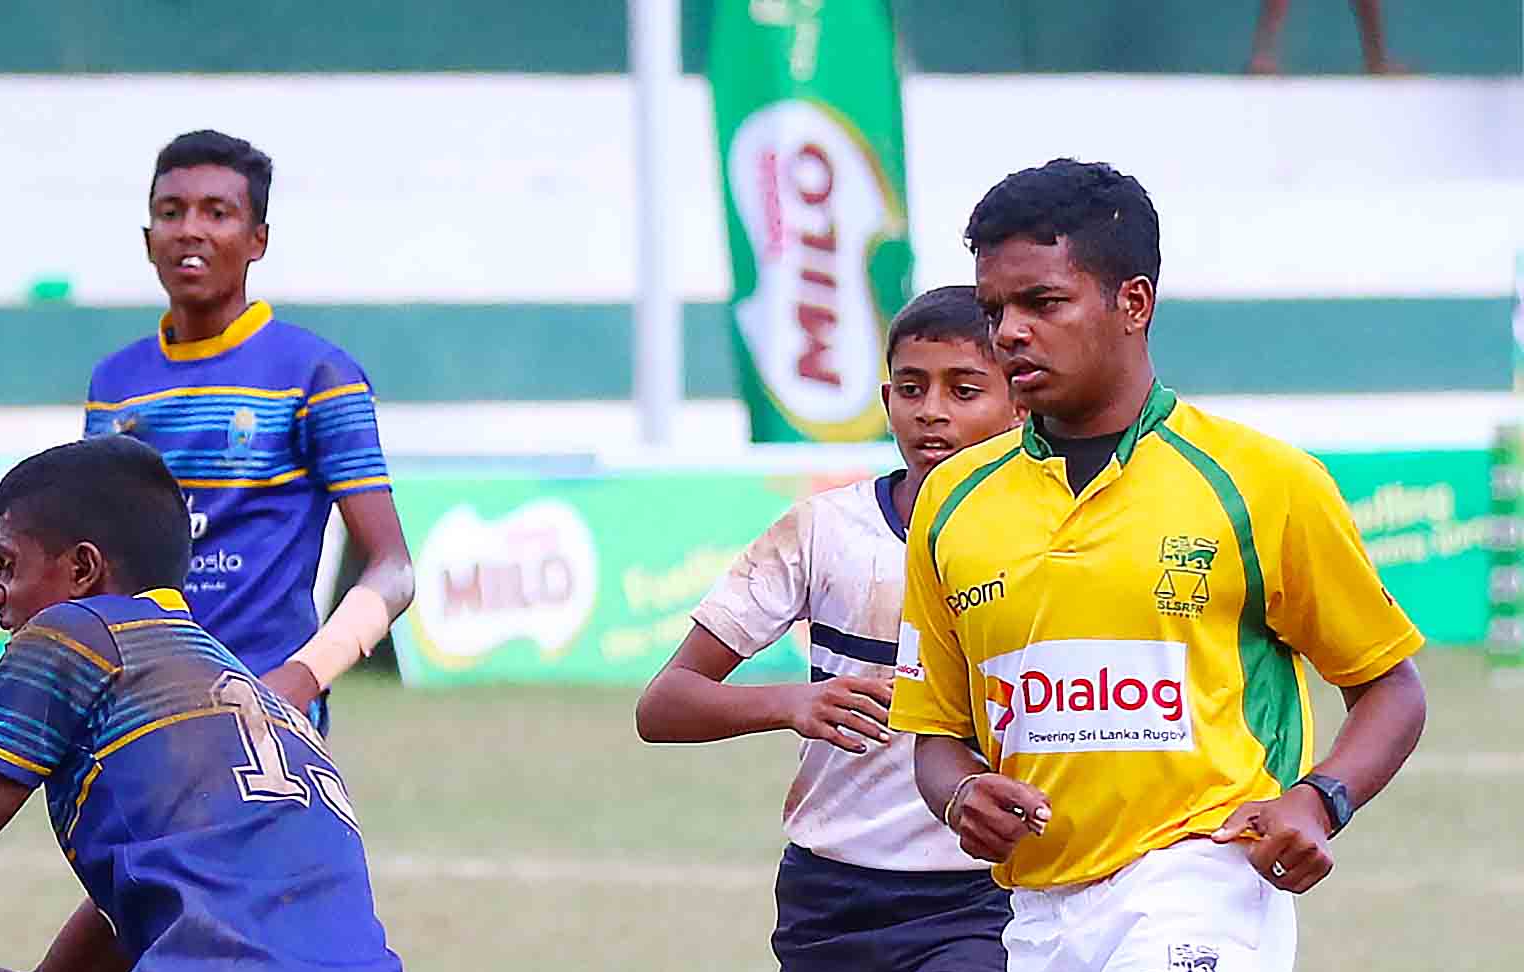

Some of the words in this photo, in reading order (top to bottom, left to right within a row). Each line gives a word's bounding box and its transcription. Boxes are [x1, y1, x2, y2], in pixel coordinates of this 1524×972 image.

[791, 143, 842, 389] MILO
[441, 555, 573, 622] MILO
[1020, 667, 1183, 722] Dialog
[1028, 731, 1075, 743] Powering
[1078, 729, 1097, 741] Sri
[1100, 729, 1140, 741] Lanka
[1143, 729, 1186, 743] Rugby
